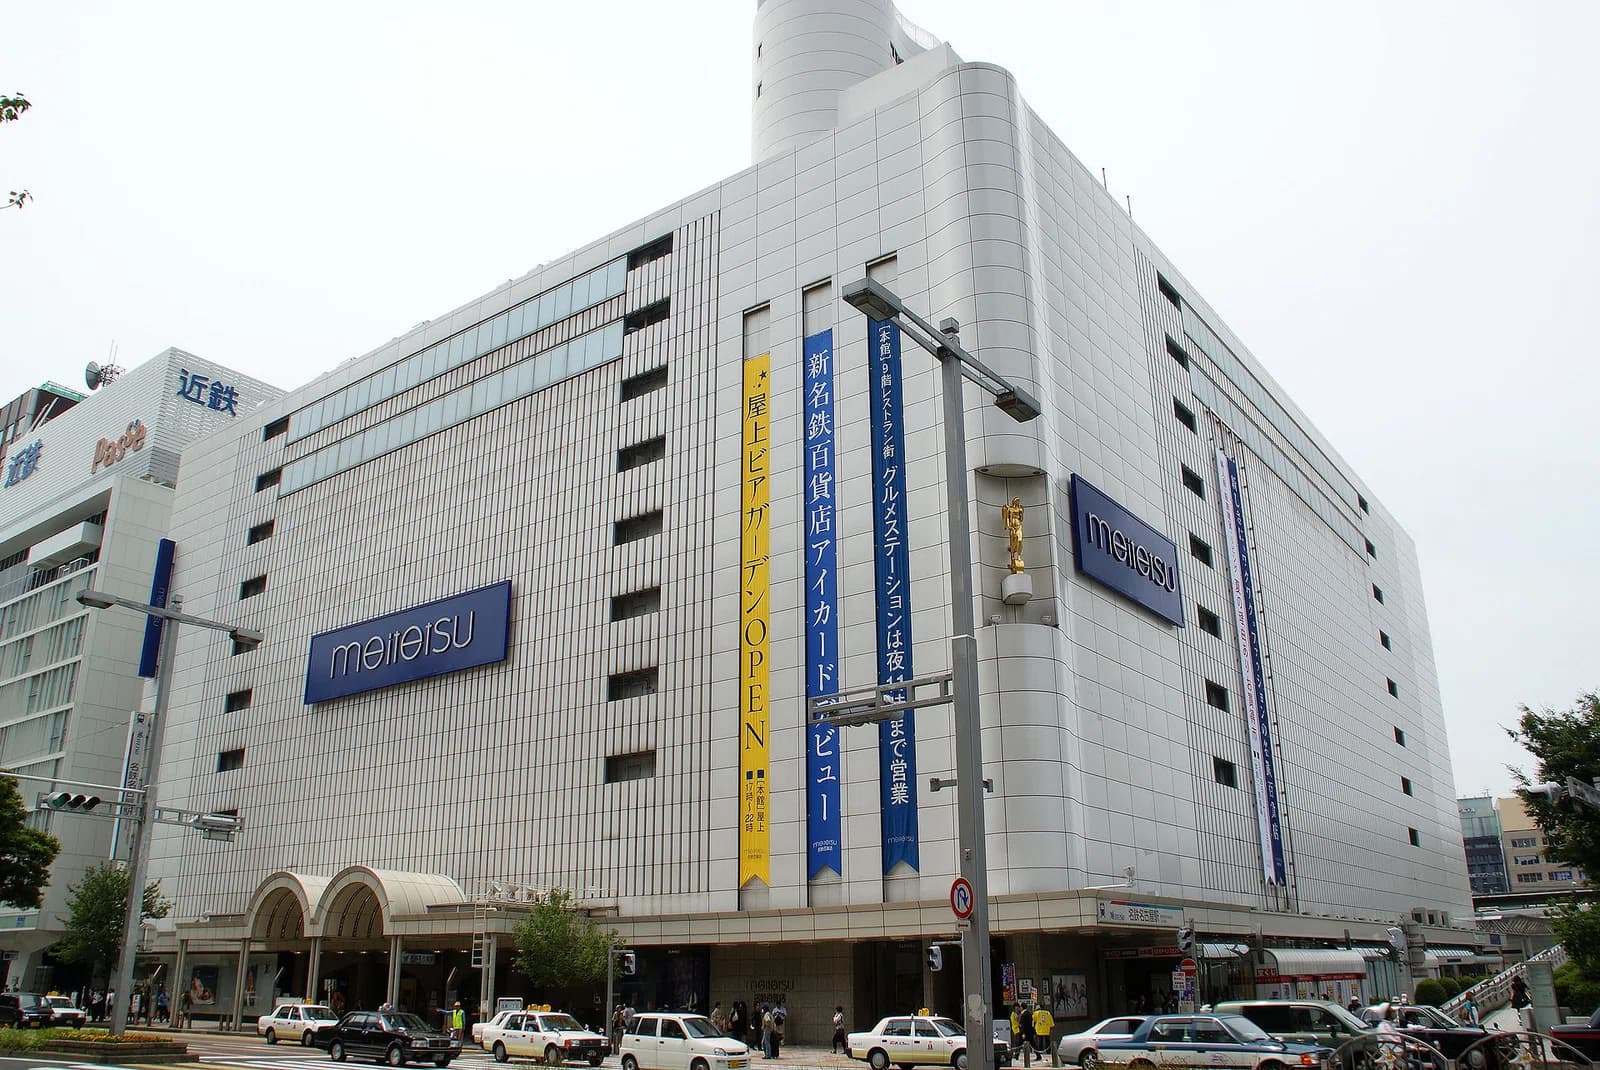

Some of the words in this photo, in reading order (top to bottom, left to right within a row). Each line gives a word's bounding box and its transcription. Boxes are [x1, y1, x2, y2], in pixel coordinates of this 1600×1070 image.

[176, 368, 240, 416] 近鉄
[4, 438, 44, 488] 近鉄
[1088, 511, 1176, 593] meitetsu
[330, 611, 476, 679] meitetsu
